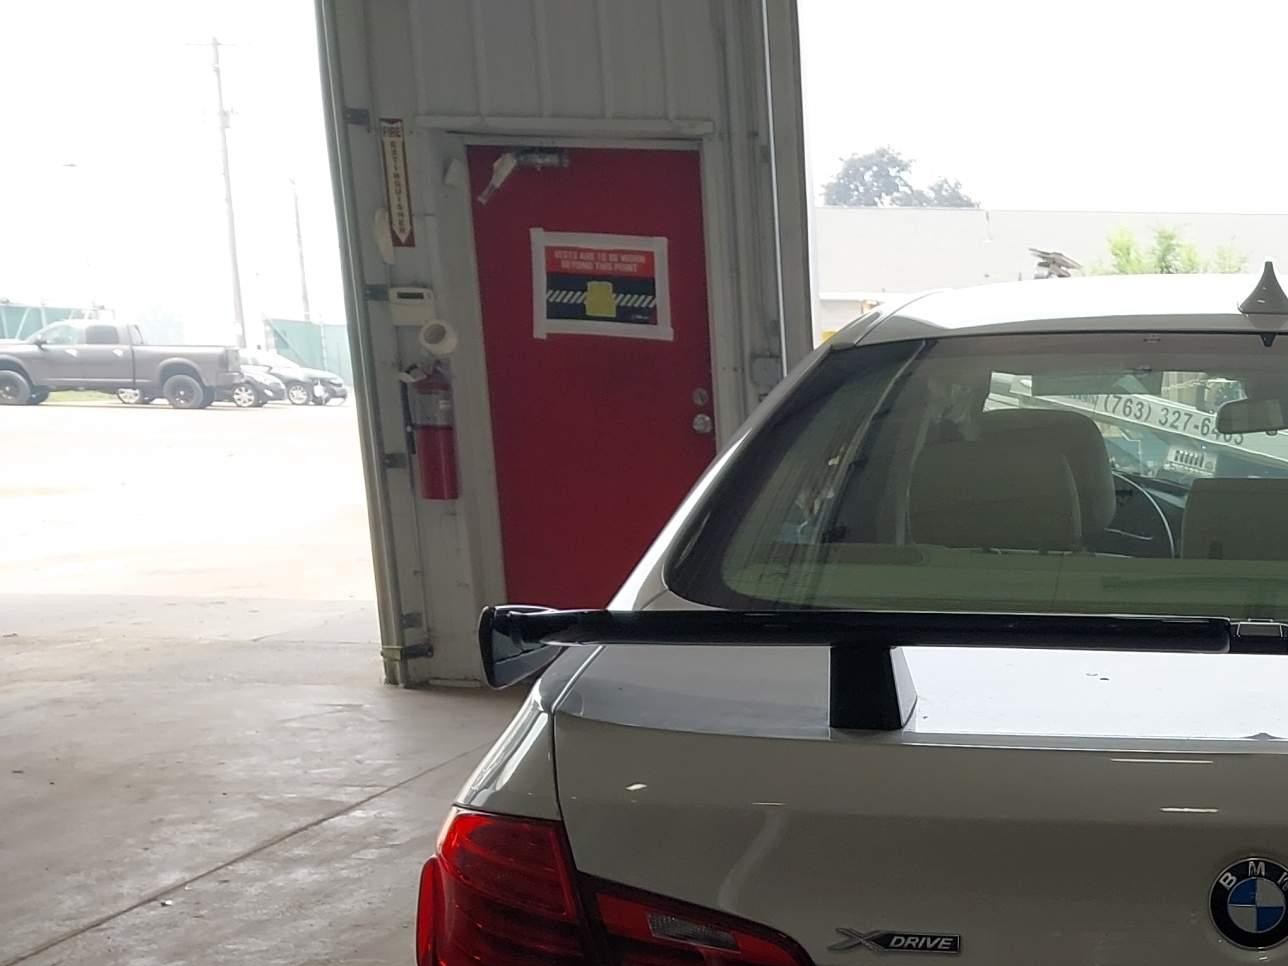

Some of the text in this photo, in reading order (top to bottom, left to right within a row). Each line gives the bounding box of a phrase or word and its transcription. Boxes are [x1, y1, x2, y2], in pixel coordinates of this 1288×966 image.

[383, 126, 401, 138] FIRE
[614, 263, 638, 273] POINT
[1103, 394, 1152, 422] (763)
